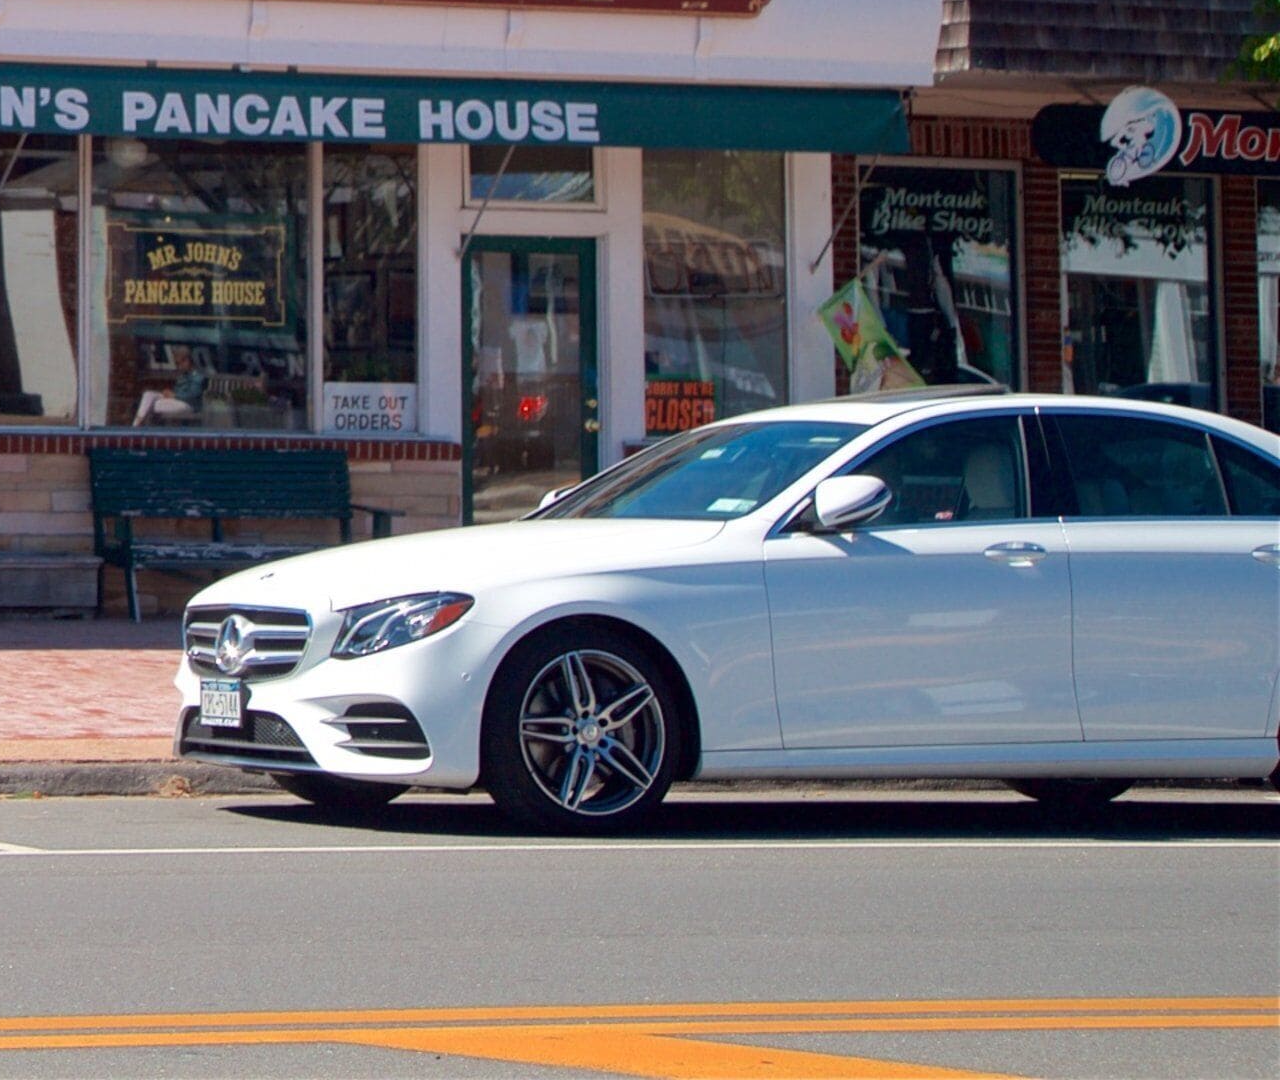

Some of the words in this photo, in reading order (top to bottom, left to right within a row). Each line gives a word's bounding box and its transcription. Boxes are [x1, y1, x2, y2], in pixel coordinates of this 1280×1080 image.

[122, 91, 385, 139] PANCAKE
[419, 99, 600, 143] HOUSE
[880, 187, 984, 210] Montauk
[1083, 195, 1182, 215] Montauk
[872, 208, 926, 234] Bike
[932, 210, 994, 238] Shop
[184, 242, 242, 271] JOHN'S
[124, 279, 204, 305] PANCAKE
[211, 280, 266, 305] HOUSE
[332, 396, 370, 410] TAKE
[378, 396, 408, 410] OUT
[646, 398, 716, 432] CLOSED
[334, 414, 403, 431] ORDERS
